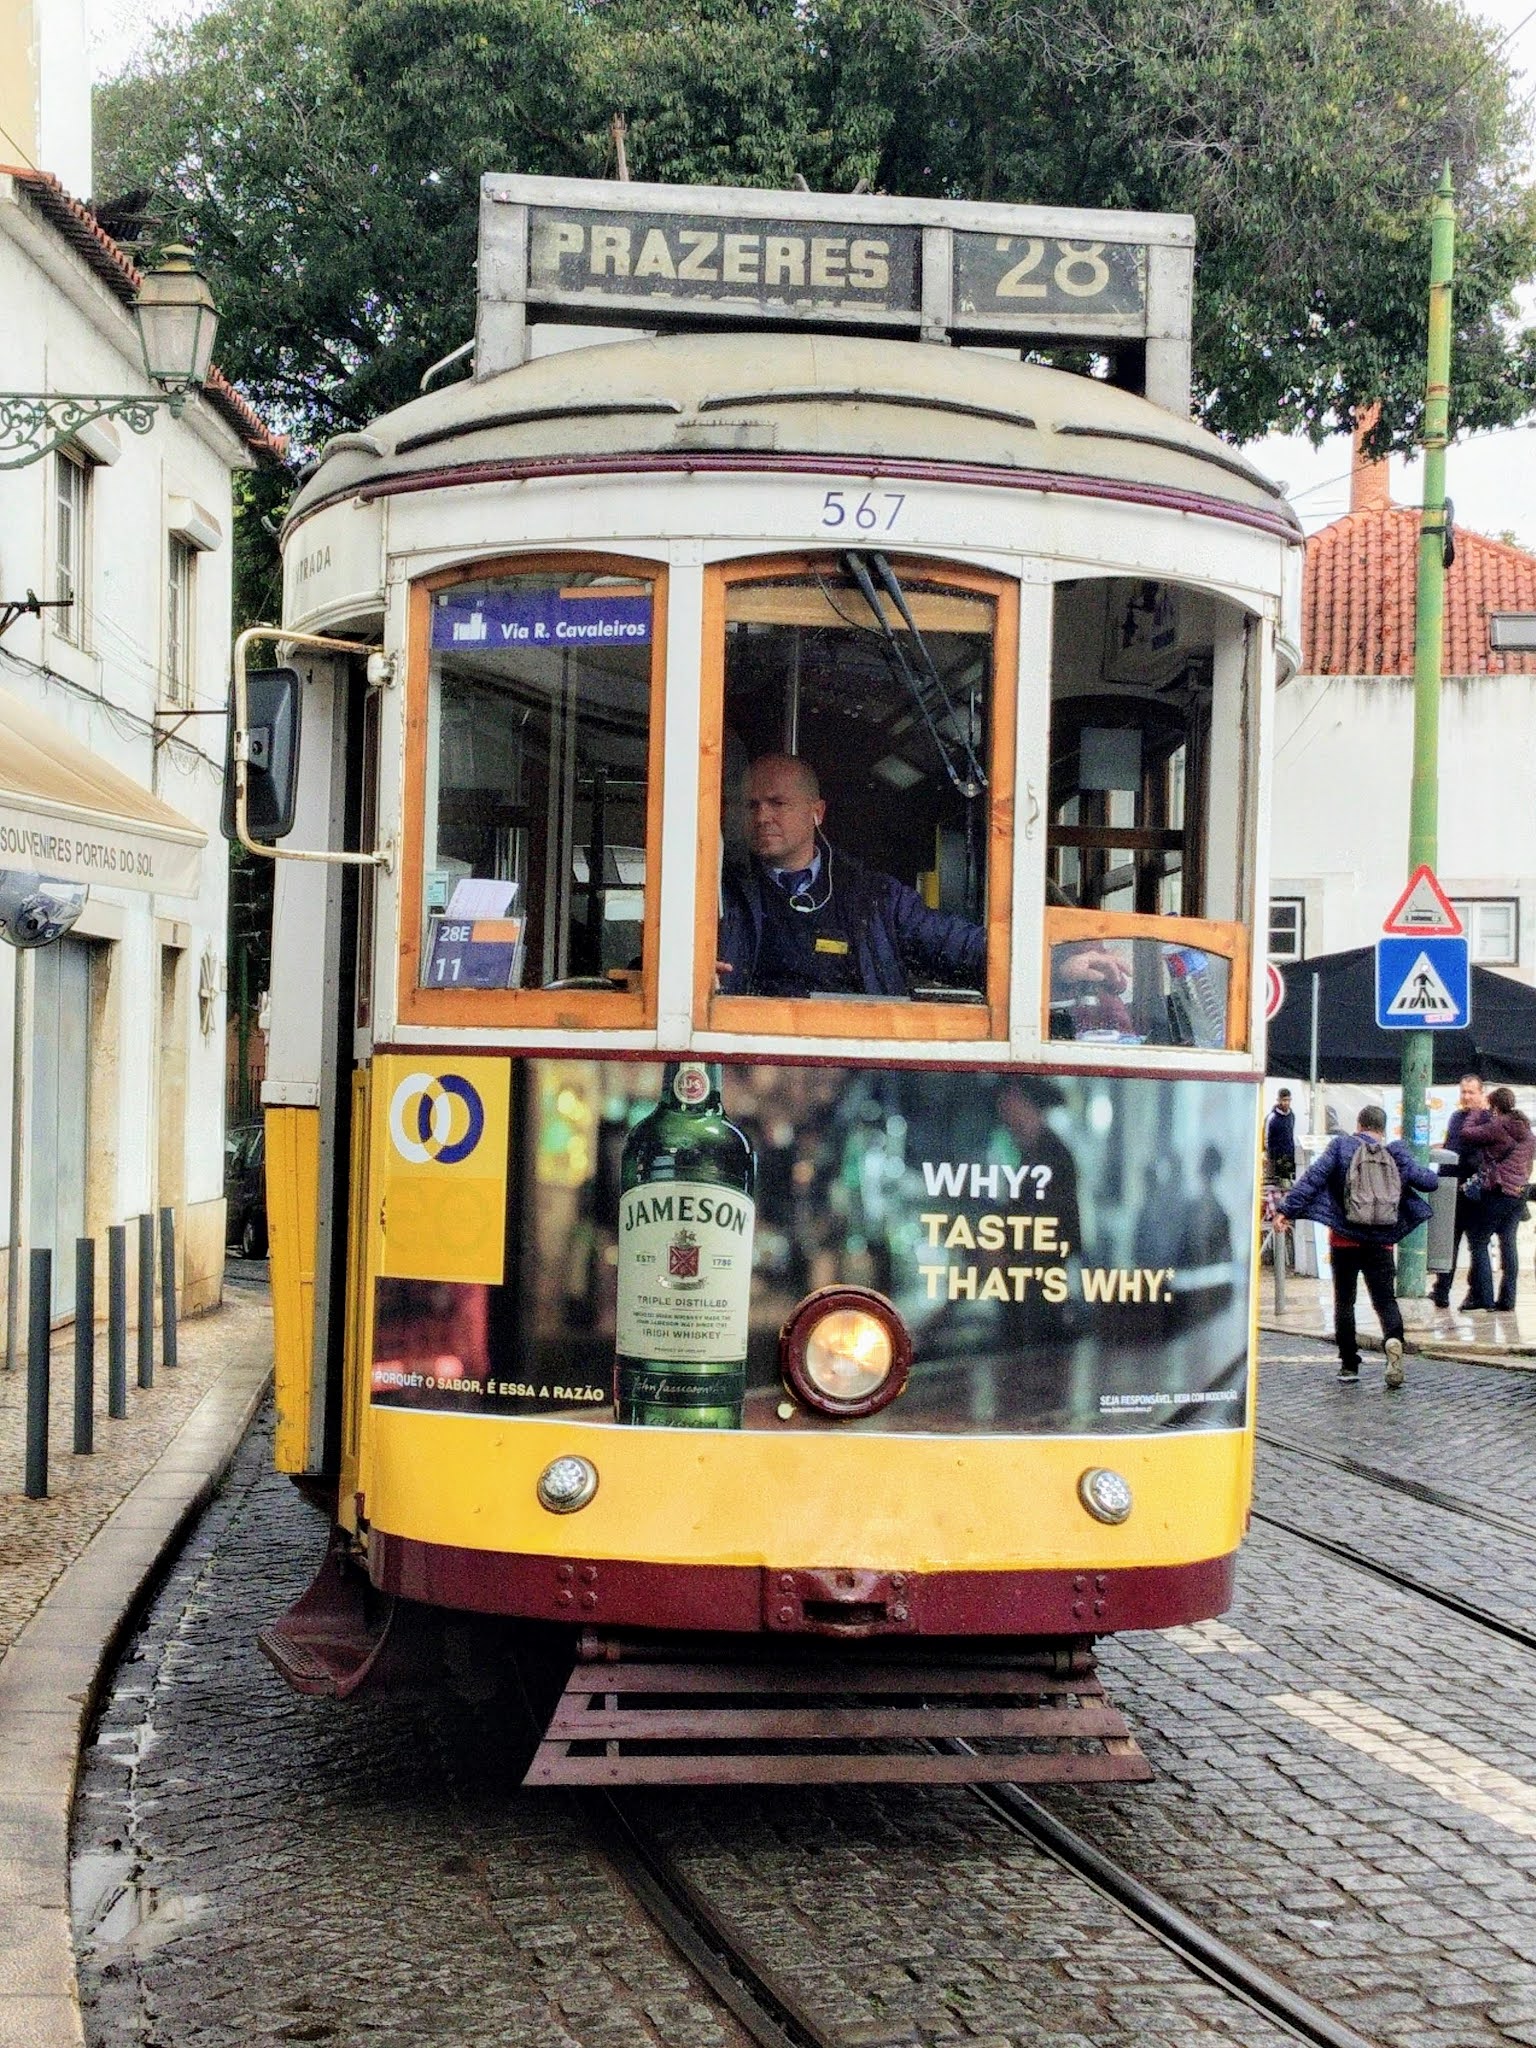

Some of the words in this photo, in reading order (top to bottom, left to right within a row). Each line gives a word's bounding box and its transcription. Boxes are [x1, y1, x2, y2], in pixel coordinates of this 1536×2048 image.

[547, 221, 890, 290] PRAZERES
[996, 236, 1110, 298] 28
[821, 491, 906, 531] 567
[501, 622, 529, 640] Via
[534, 622, 550, 640] R.
[555, 620, 646, 639] Cavaleiros
[75, 841, 117, 871] PORTAS
[119, 850, 134, 874] DO
[136, 852, 154, 878] SOL
[438, 925, 471, 942] 28E
[435, 958, 461, 981] 11
[922, 1162, 1053, 1200] WHY?
[625, 1195, 747, 1237] JAMESON
[920, 1213, 1070, 1258] TASTE,
[637, 1295, 671, 1306] TRIPLE
[675, 1298, 728, 1308] DISTILLED
[918, 1265, 1068, 1303] THAT'S
[642, 1328, 669, 1338] IRISH
[673, 1330, 721, 1340] WHISKEY
[426, 1375, 434, 1388] O
[437, 1375, 484, 1396] SABOR,
[487, 1378, 496, 1394] É
[499, 1382, 535, 1397] ESSA
[539, 1385, 550, 1398] A
[553, 1384, 604, 1401] RAZÃO
[1100, 1394, 1120, 1406] SEJA
